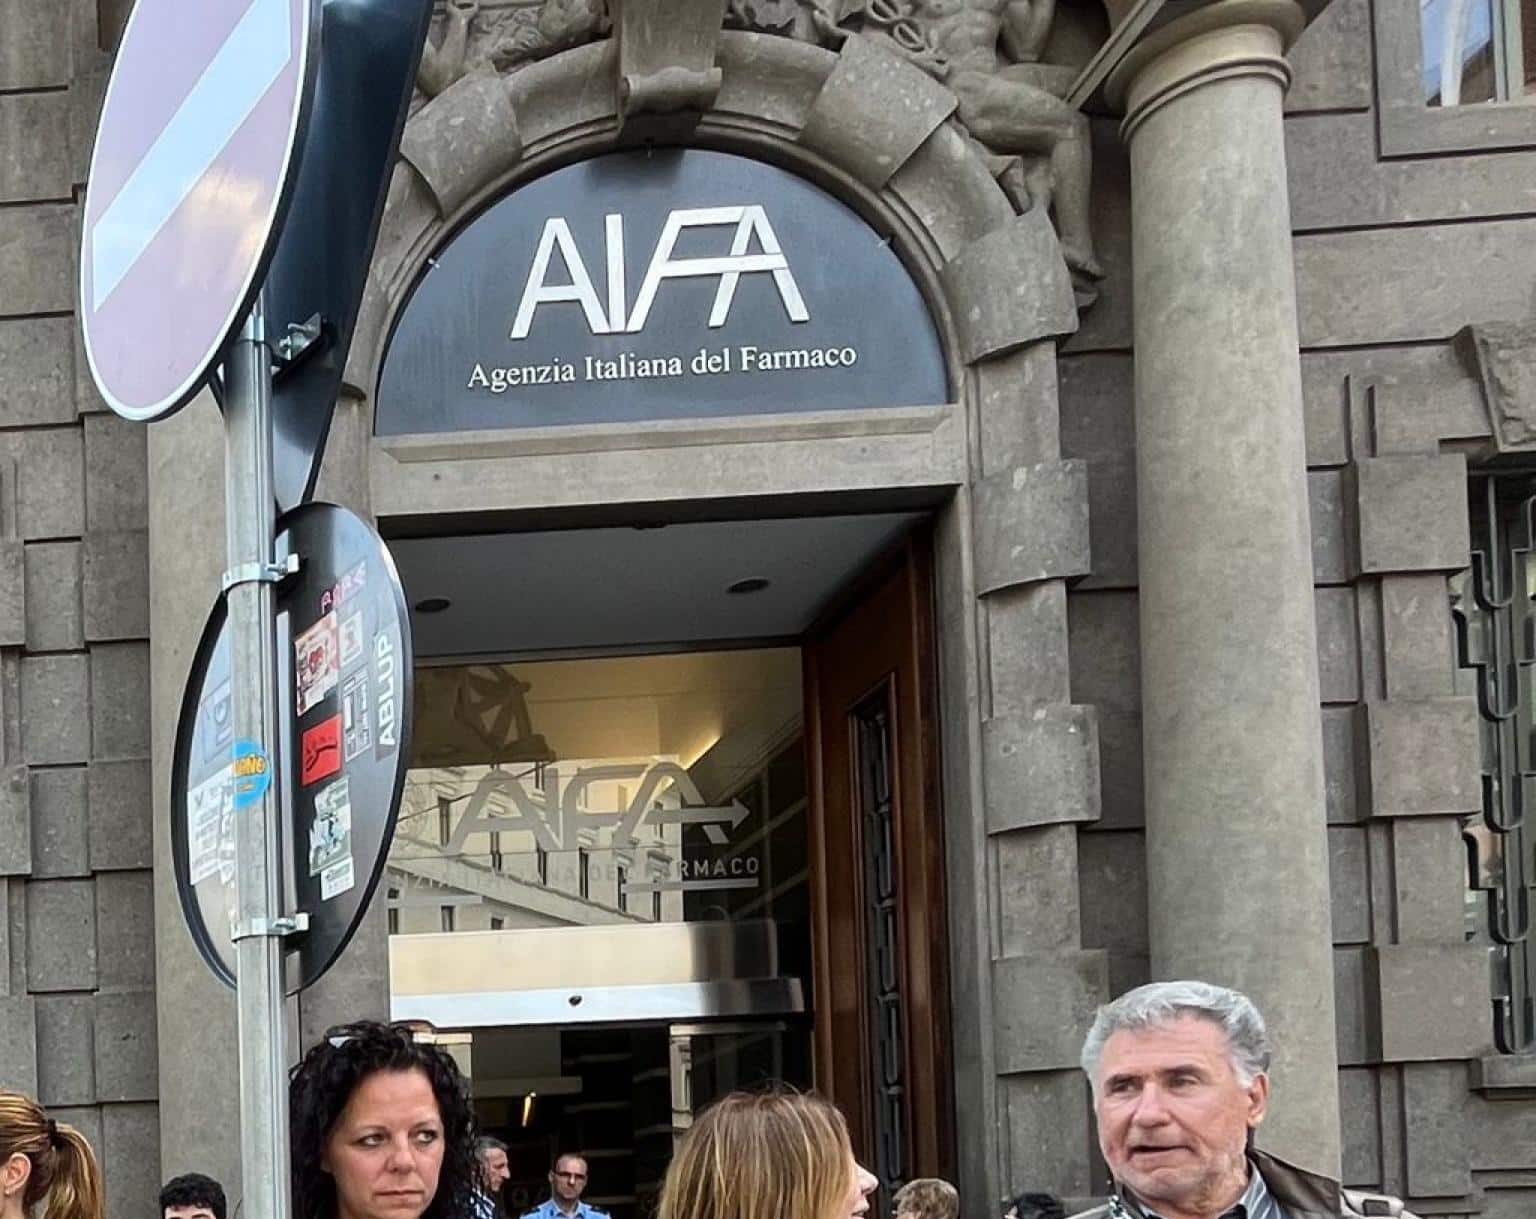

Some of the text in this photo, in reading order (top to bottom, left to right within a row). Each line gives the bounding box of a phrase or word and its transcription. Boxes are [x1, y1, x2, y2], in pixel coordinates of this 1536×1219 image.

[510, 204, 810, 340] AIFA
[467, 345, 857, 393] Agenzia Italiana del Farmaco
[646, 856, 759, 879] RMACO
